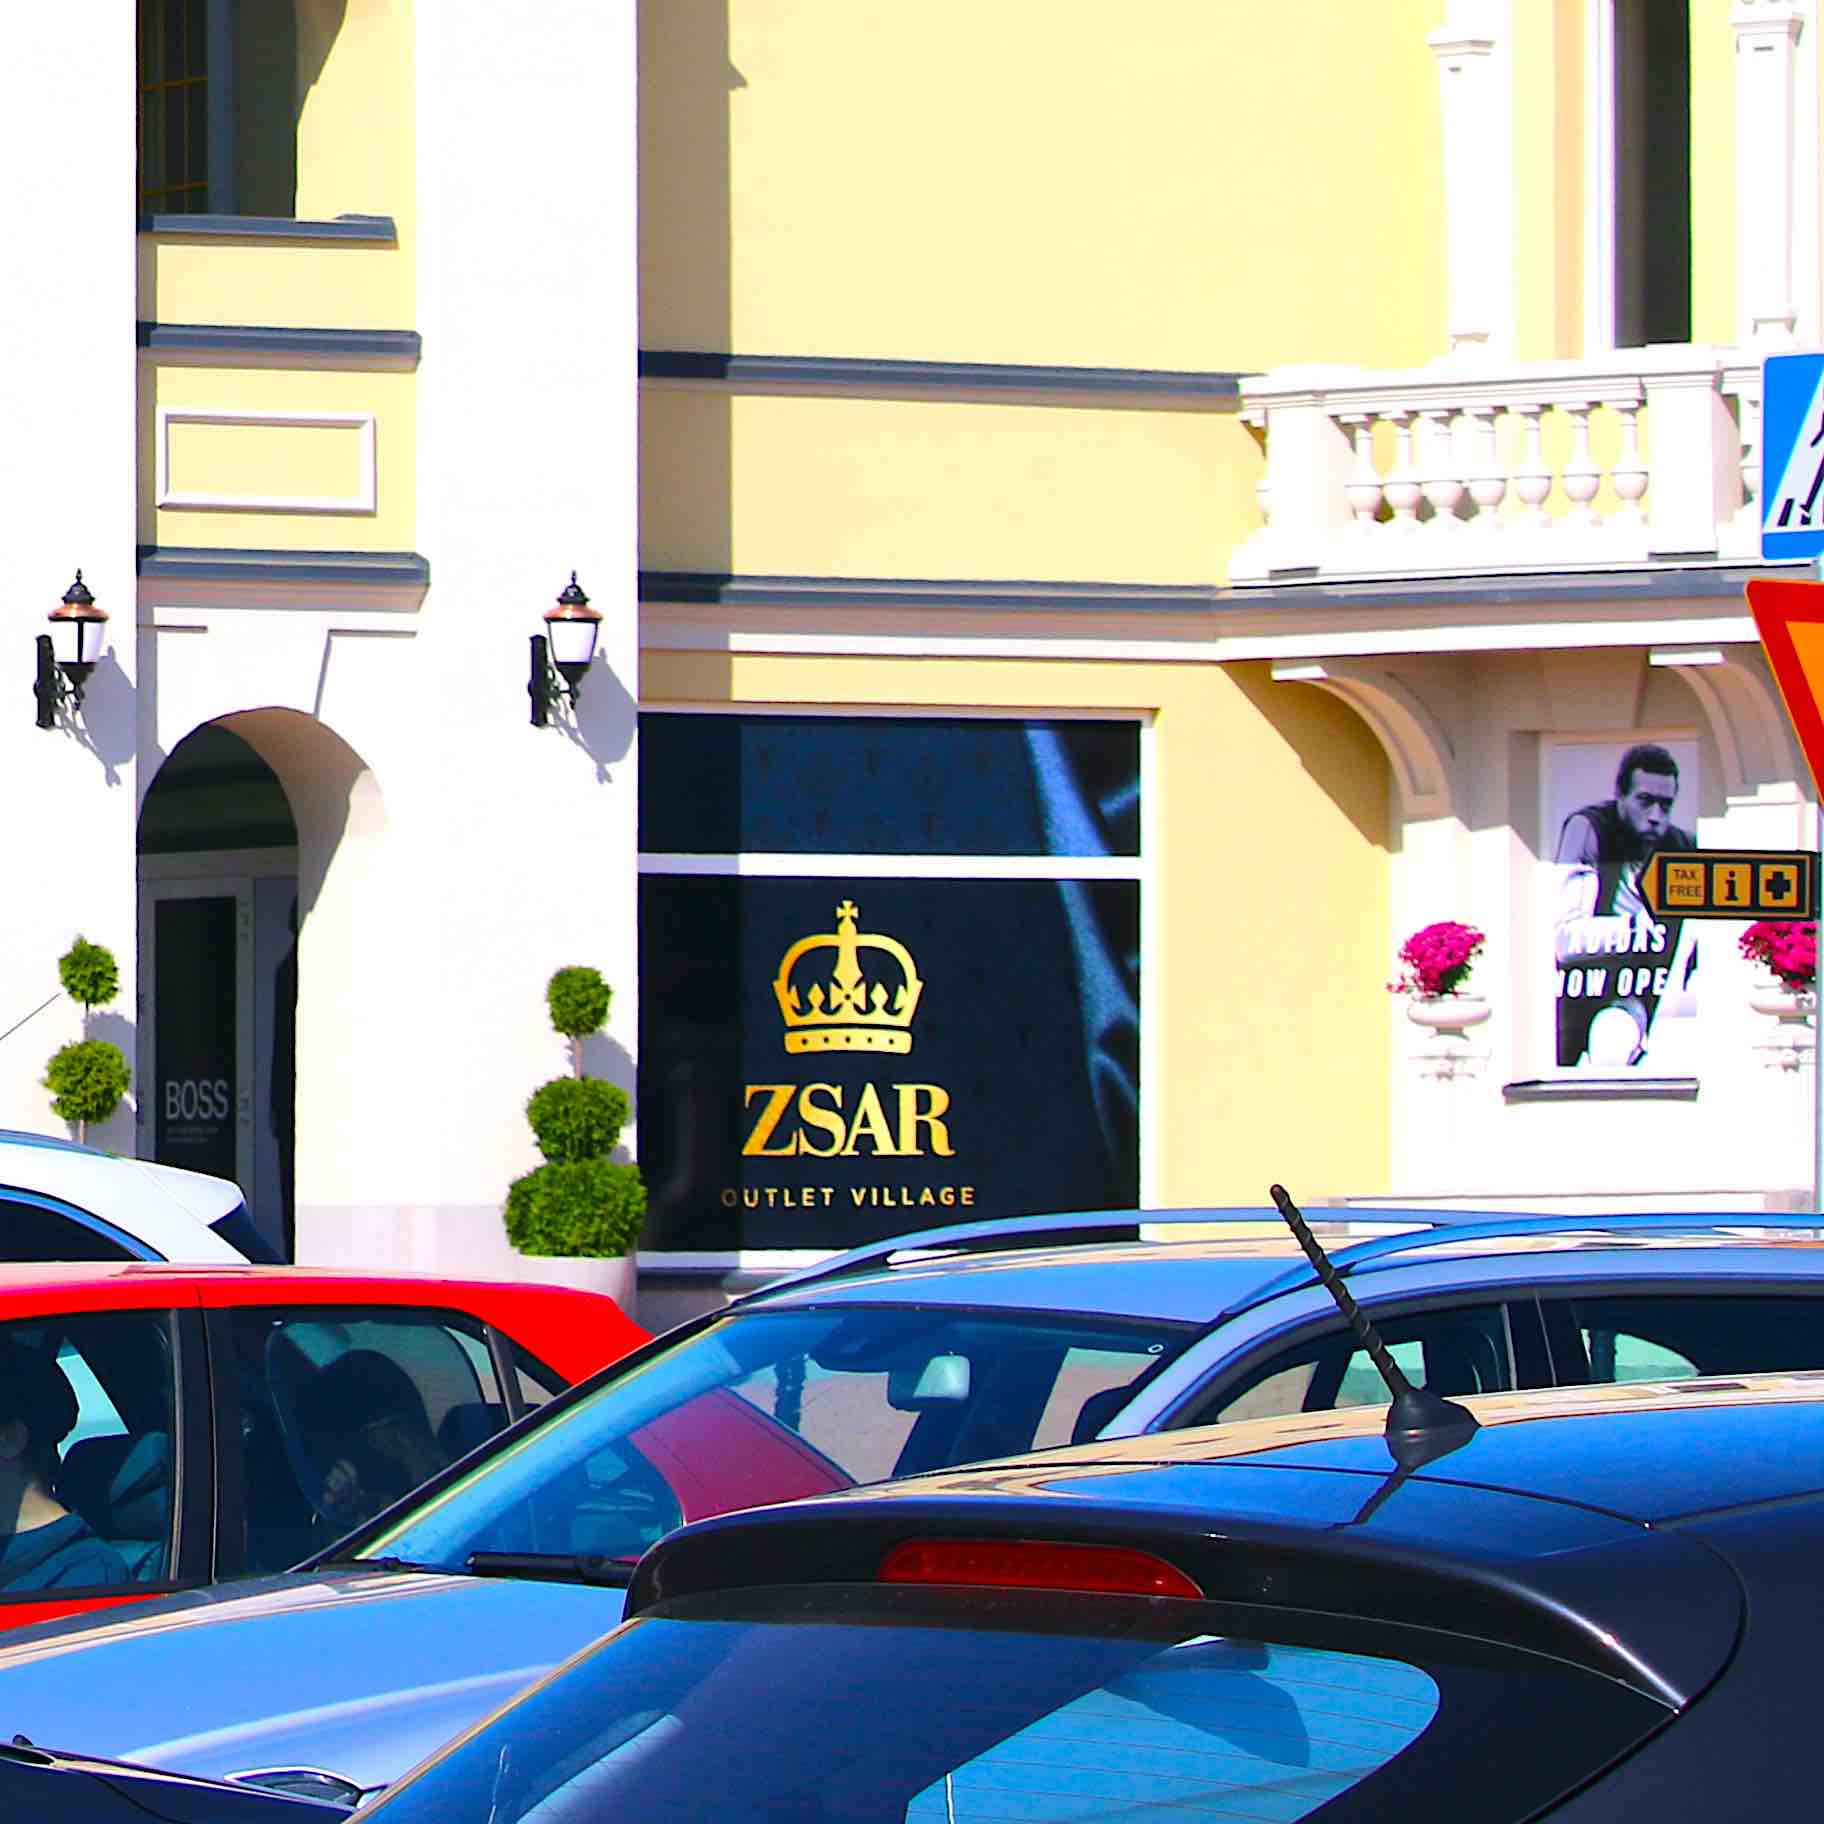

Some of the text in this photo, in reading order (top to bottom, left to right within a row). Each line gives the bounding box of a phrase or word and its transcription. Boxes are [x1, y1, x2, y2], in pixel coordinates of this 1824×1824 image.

[1673, 869, 1697, 881] TAX
[1669, 884, 1704, 897] FREE
[1616, 967, 1670, 996] OPE
[165, 1080, 229, 1120] BOSS
[742, 1083, 956, 1157] ZSAR
[721, 1186, 975, 1207] OUTLET VILLAGE
